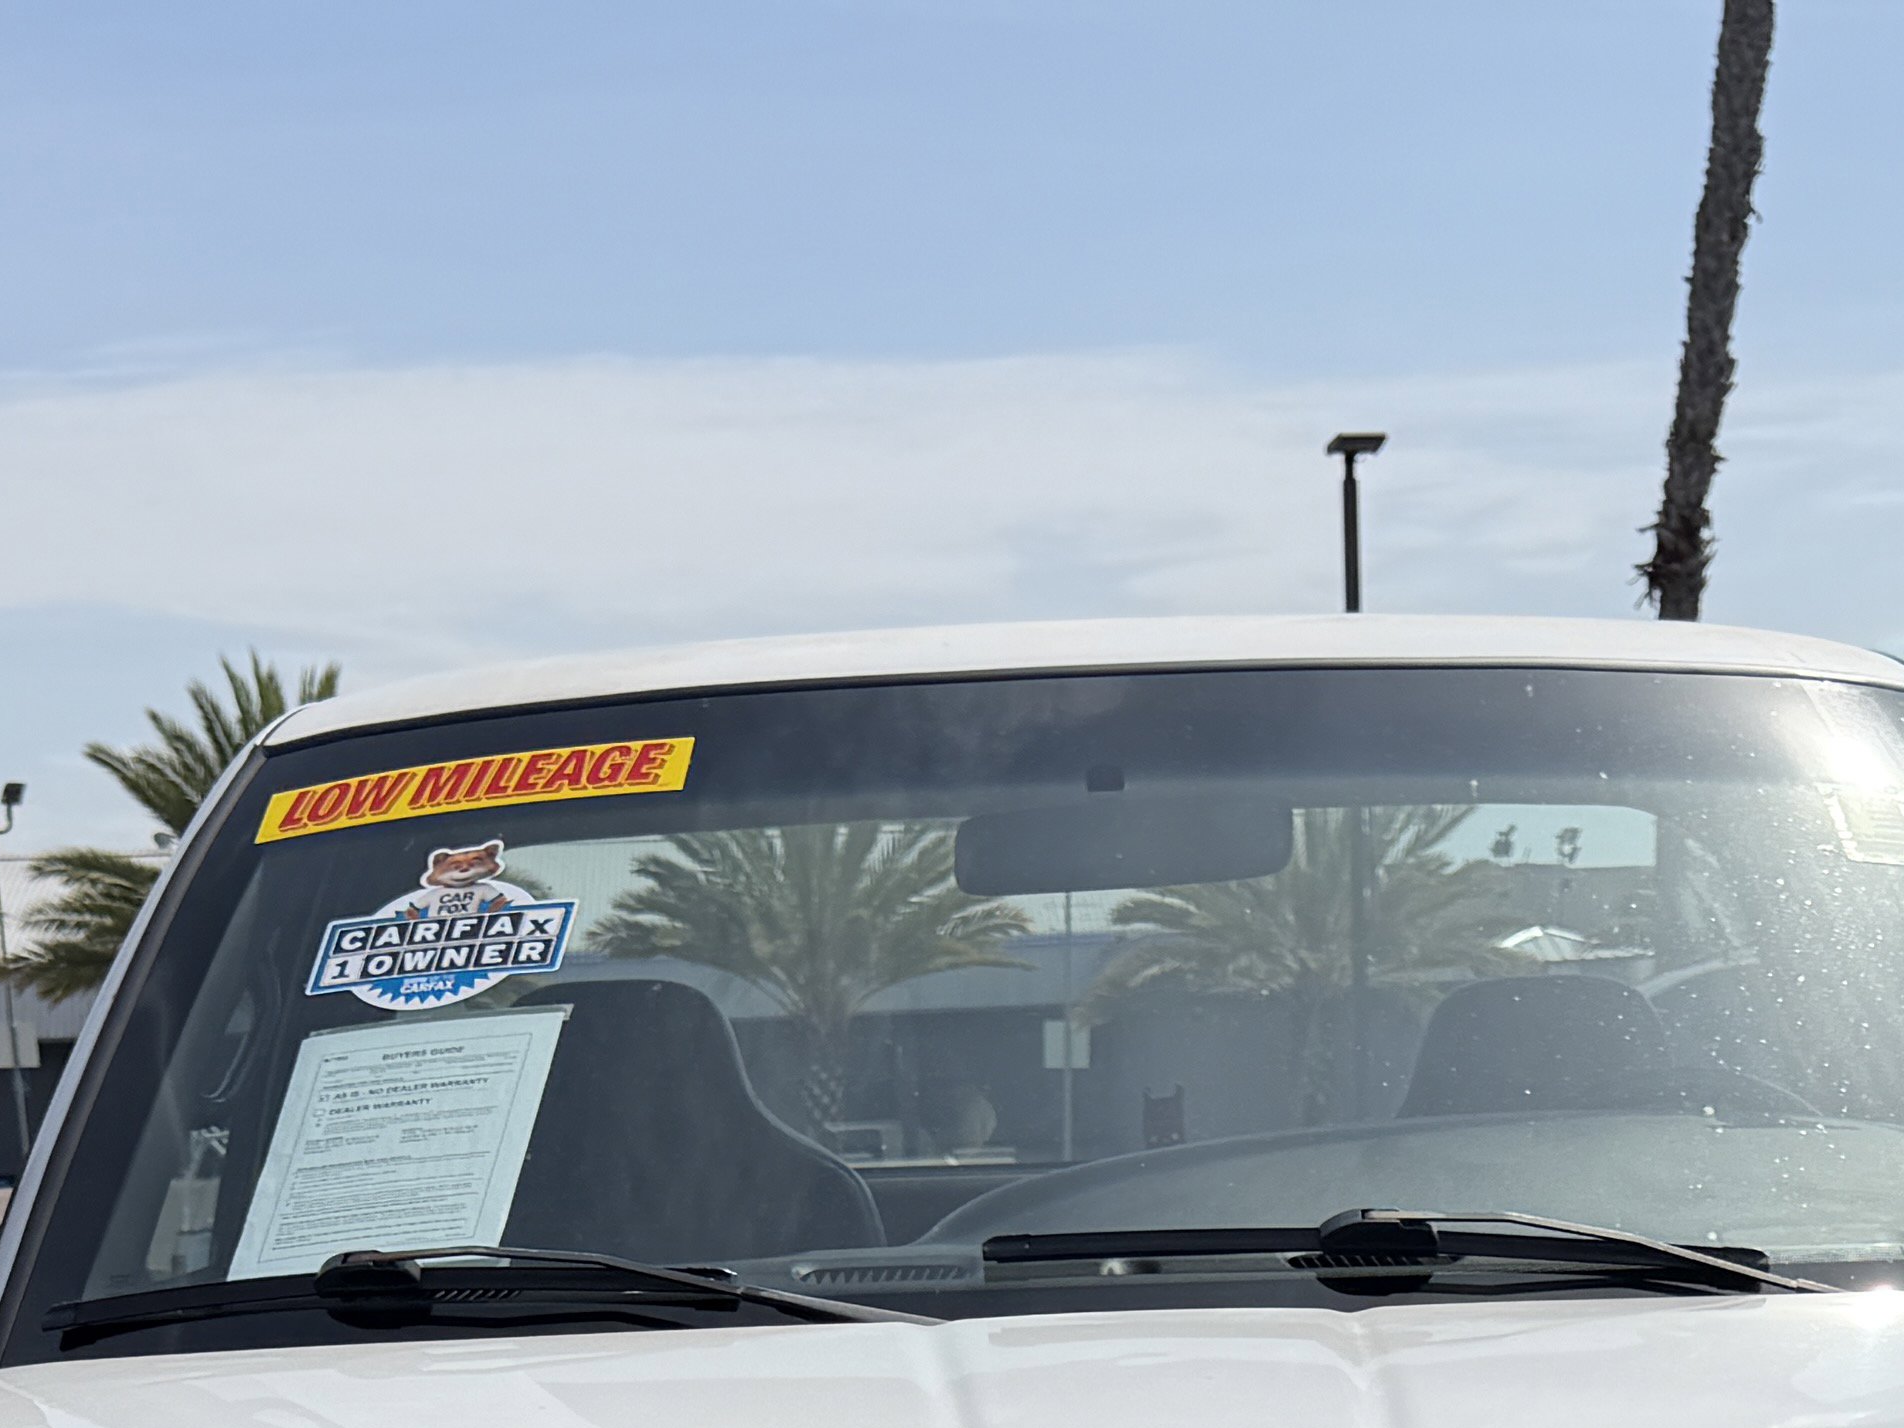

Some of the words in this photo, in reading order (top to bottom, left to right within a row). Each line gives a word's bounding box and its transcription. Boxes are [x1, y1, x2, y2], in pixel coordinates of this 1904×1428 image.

[277, 771, 418, 832] LOW
[407, 742, 677, 809] MILEAGE
[437, 902, 472, 916] FOX
[438, 890, 475, 905] CAR
[339, 915, 556, 952] CARFAX
[366, 940, 548, 976] OWNER
